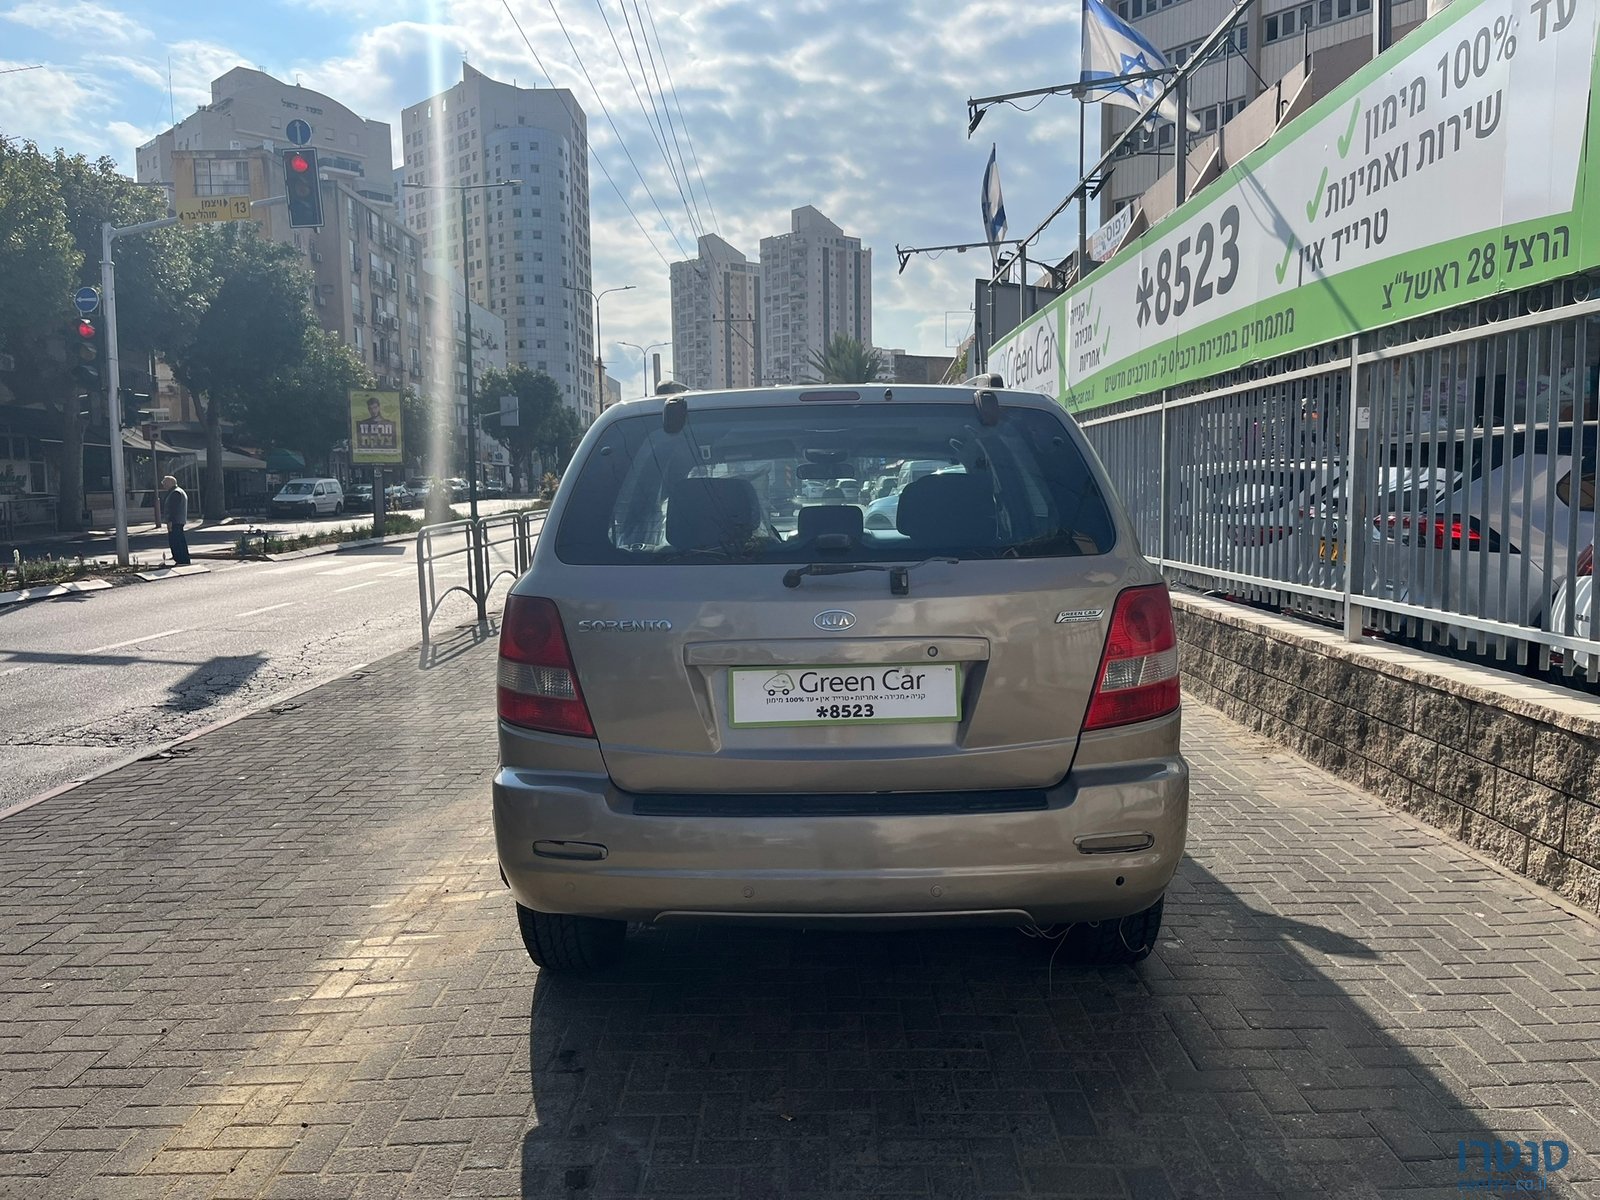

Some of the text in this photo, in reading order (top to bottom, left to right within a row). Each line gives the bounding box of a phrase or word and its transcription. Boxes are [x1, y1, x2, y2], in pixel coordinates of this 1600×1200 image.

[1364, 0, 1576, 155] עד 100% מימון
[1324, 89, 1503, 218] שירות ואמינות
[186, 209, 217, 220] מוהליבר
[201, 199, 222, 209] ויצמן
[234, 201, 247, 213] 13
[1298, 207, 1389, 287] טרייד אין
[1503, 225, 1570, 273] הרצל
[1466, 243, 1496, 286] 28
[1070, 302, 1085, 326] קנייה
[1074, 324, 1093, 350] מכירה
[1241, 307, 1295, 349] מתמחים
[1006, 325, 1055, 388] Green Car
[1198, 329, 1238, 364] במכירת
[1079, 347, 1101, 373] אחריות
[1104, 371, 1126, 394] חדשים
[1127, 361, 1150, 387] ורכבים
[578, 619, 673, 632] SORENTO
[822, 614, 849, 626] KIA
[799, 669, 926, 693] Green Car
[766, 697, 784, 705] מימון
[820, 695, 830, 704] אין
[884, 693, 905, 701] מכירה
[910, 692, 926, 701] קניה
